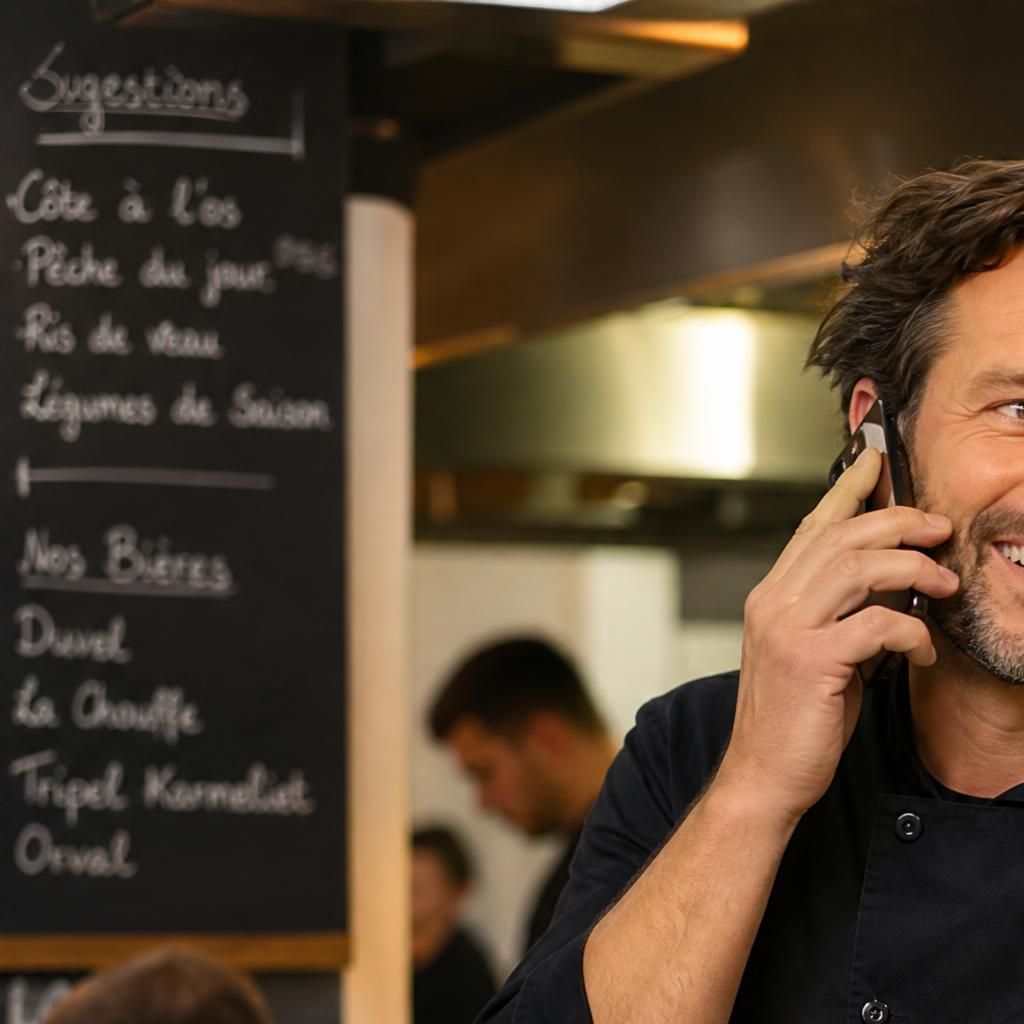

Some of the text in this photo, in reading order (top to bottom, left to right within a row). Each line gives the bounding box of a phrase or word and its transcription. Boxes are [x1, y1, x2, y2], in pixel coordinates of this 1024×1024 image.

[14, 168, 98, 225] Côte
[117, 178, 152, 225] à
[138, 244, 192, 289] du
[88, 311, 133, 356] de
[20, 368, 157, 440] Légumes
[170, 382, 217, 427] de
[17, 526, 87, 581] Nos
[14, 603, 132, 664] Duvel
[9, 749, 129, 826] Tripel
[14, 822, 138, 879] Orval
